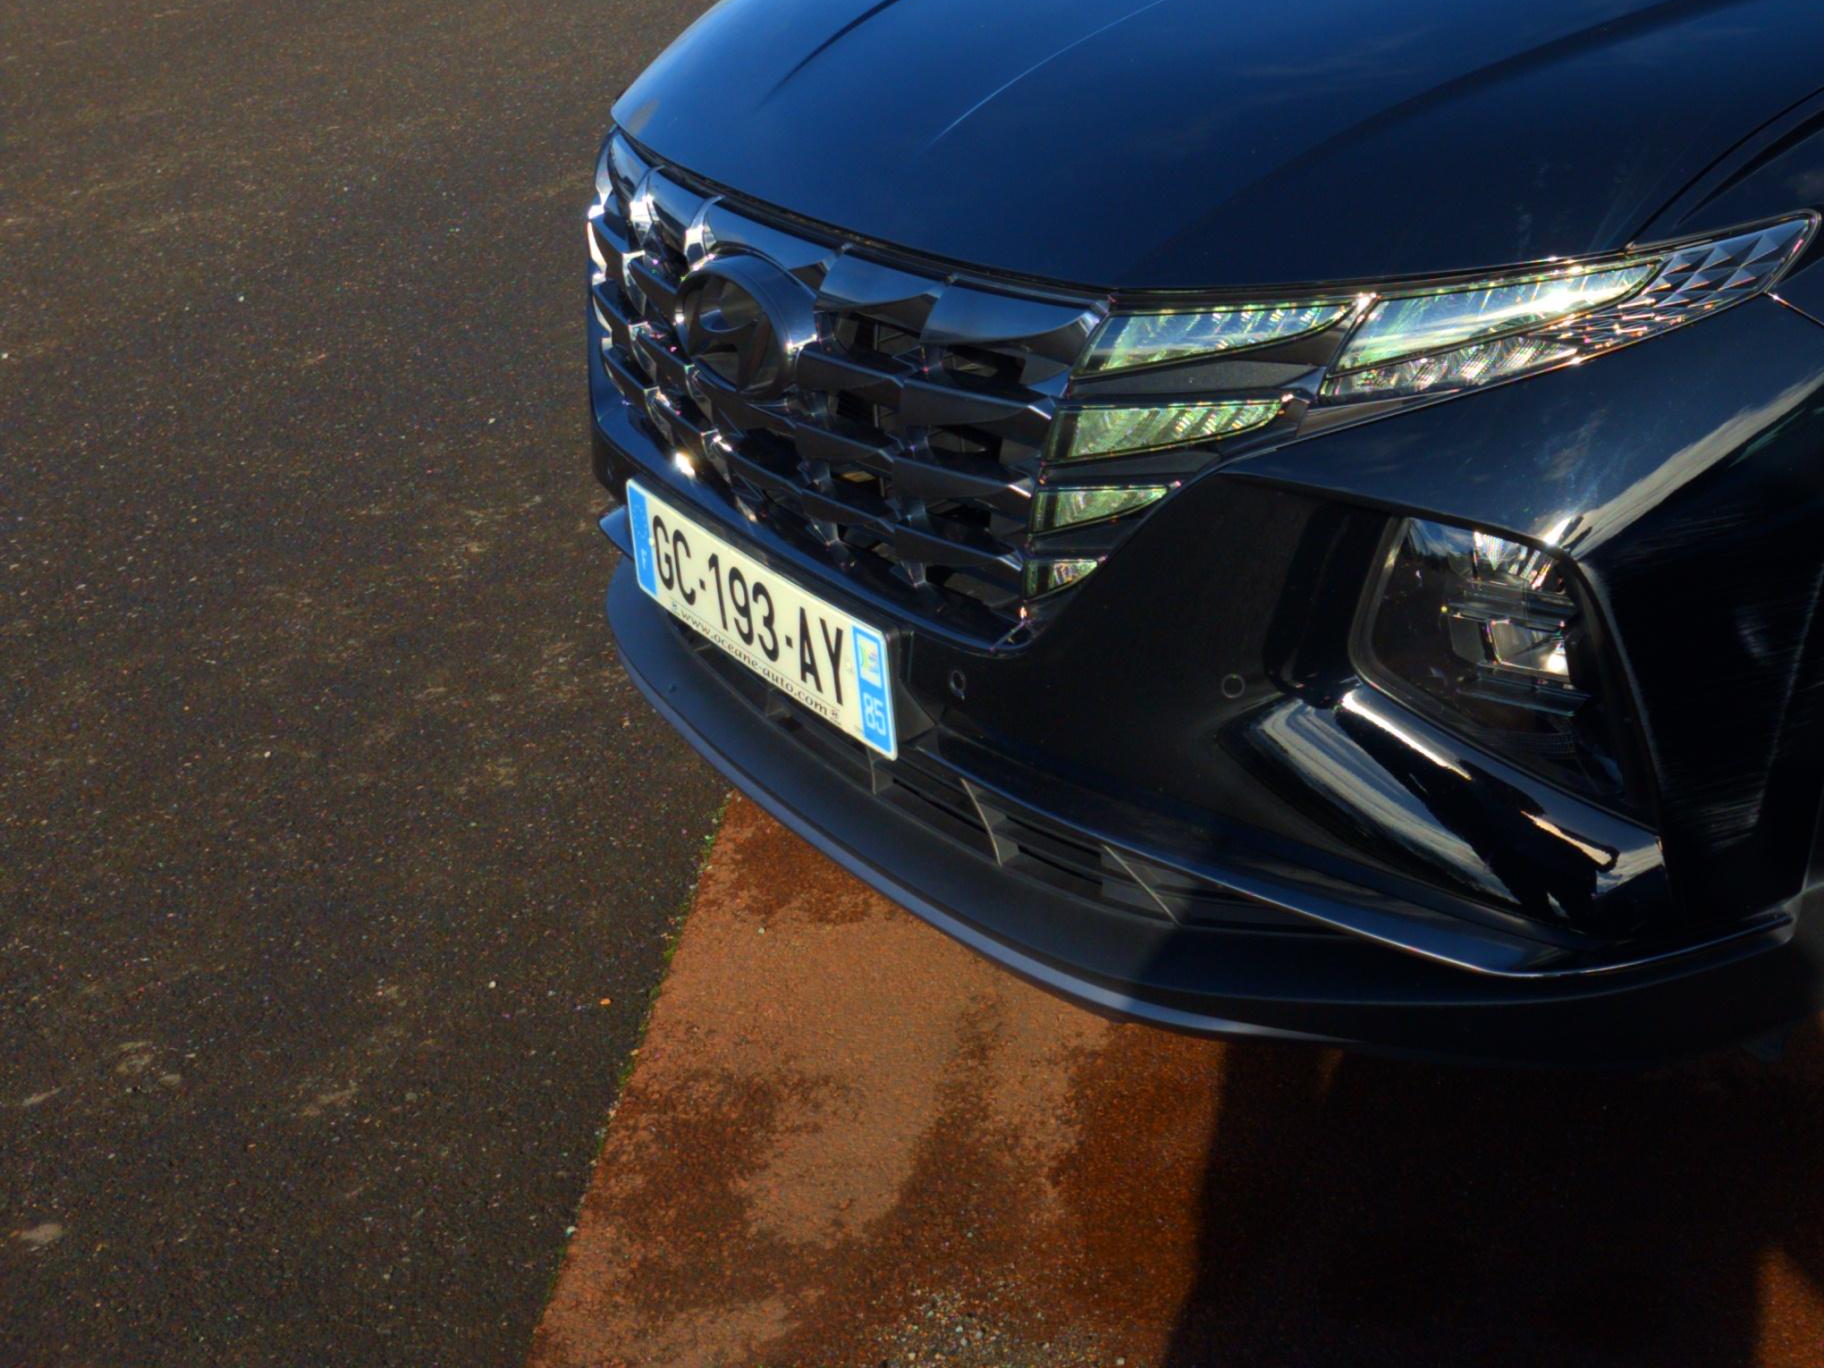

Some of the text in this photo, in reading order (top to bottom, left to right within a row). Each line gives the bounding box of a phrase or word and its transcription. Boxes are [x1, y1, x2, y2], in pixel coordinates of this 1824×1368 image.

[652, 515, 845, 706] GC-193-AY
[680, 610, 828, 716] www.oceane-auto.com
[863, 692, 887, 736] 85
